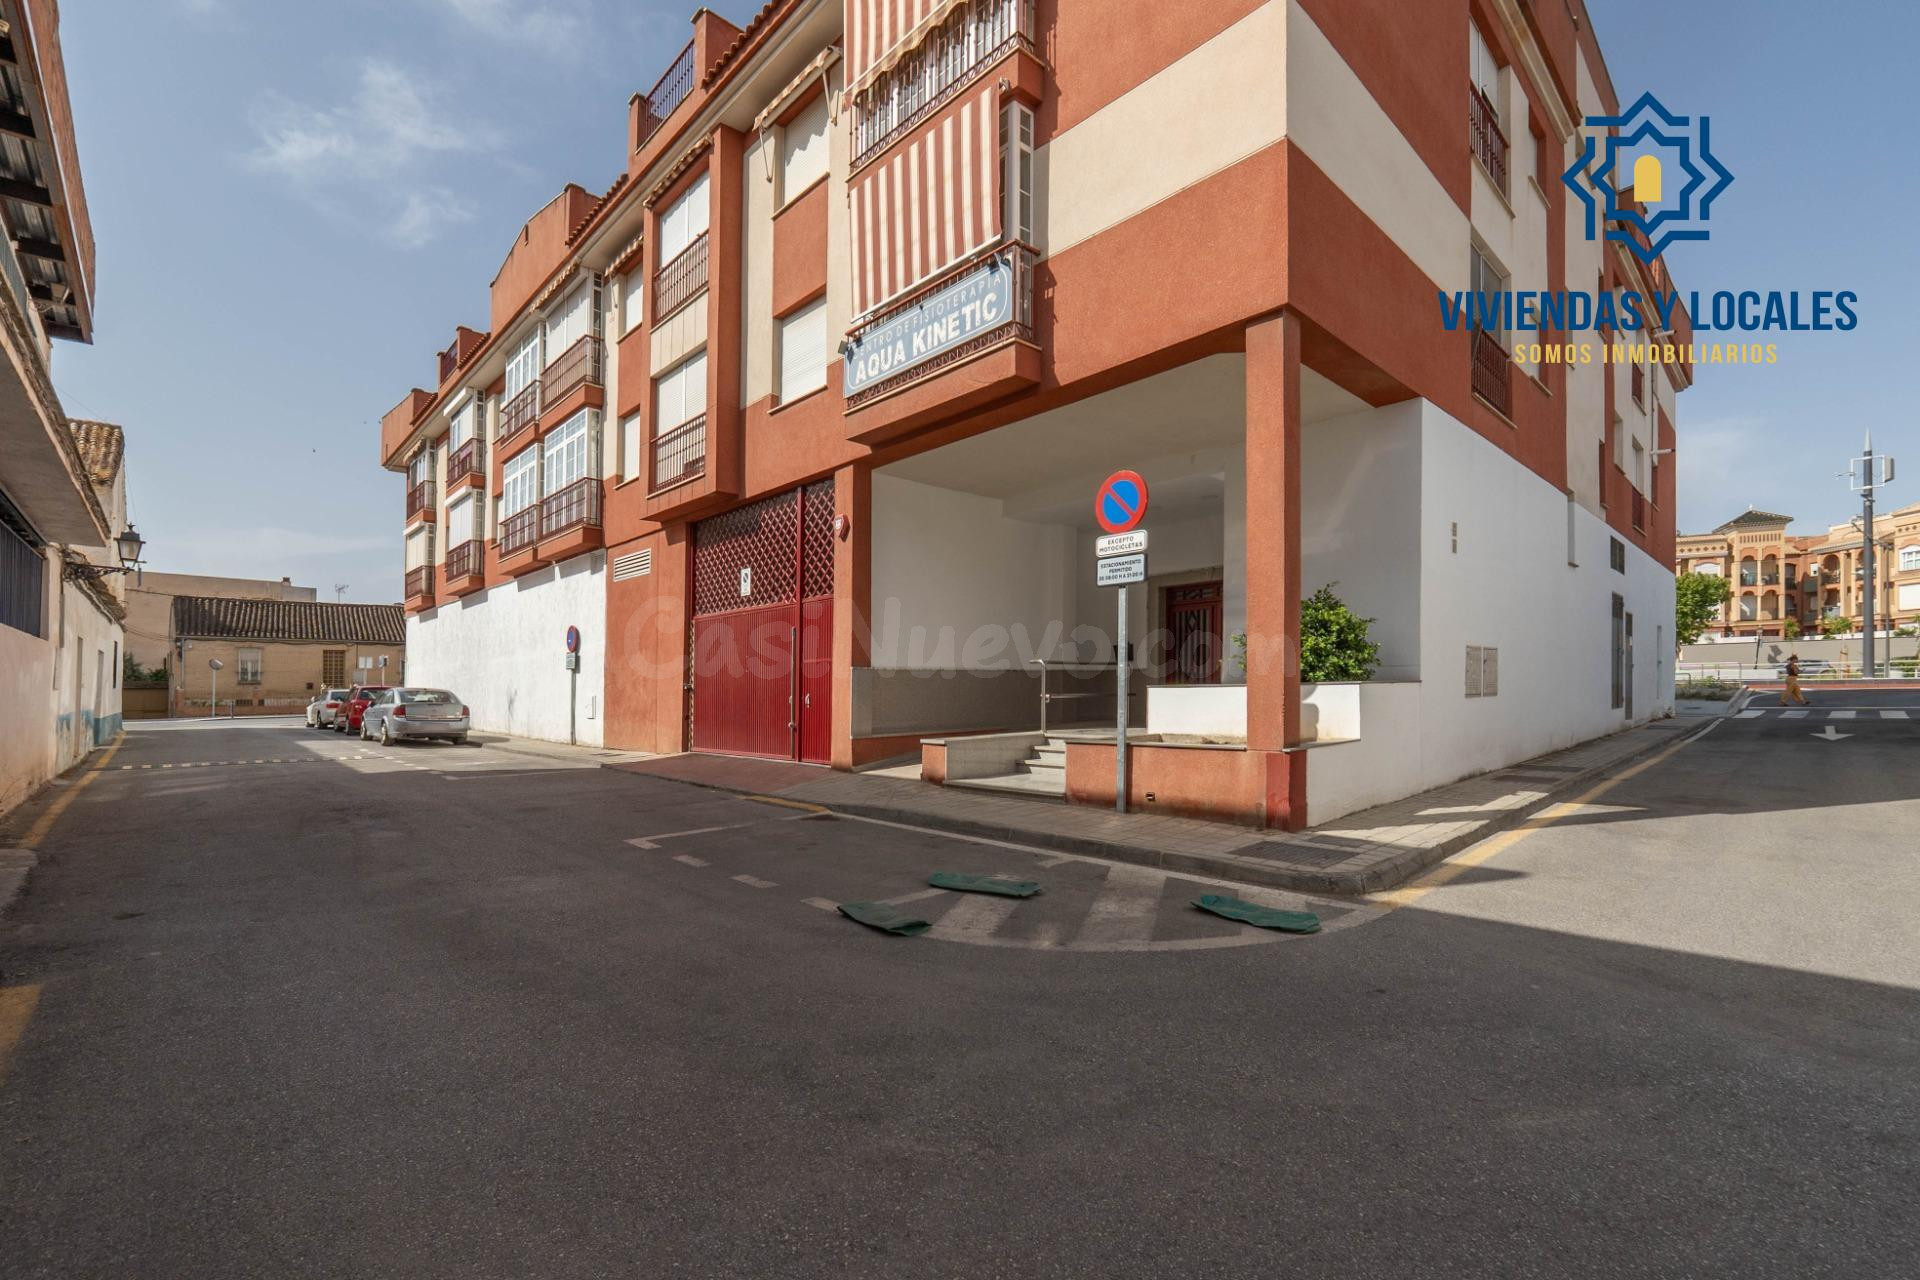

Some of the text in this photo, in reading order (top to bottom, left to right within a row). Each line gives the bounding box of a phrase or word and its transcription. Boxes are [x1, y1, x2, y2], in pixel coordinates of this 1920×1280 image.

[853, 277, 1001, 359] CENTRO DE FISIOTERAPIA
[855, 292, 998, 385] AQUA KINETIC
[1107, 536, 1134, 545] EXCEPTO
[1099, 542, 1142, 552] MOTOCICLETAS
[1100, 558, 1141, 568] ESTACIONAMIENTO
